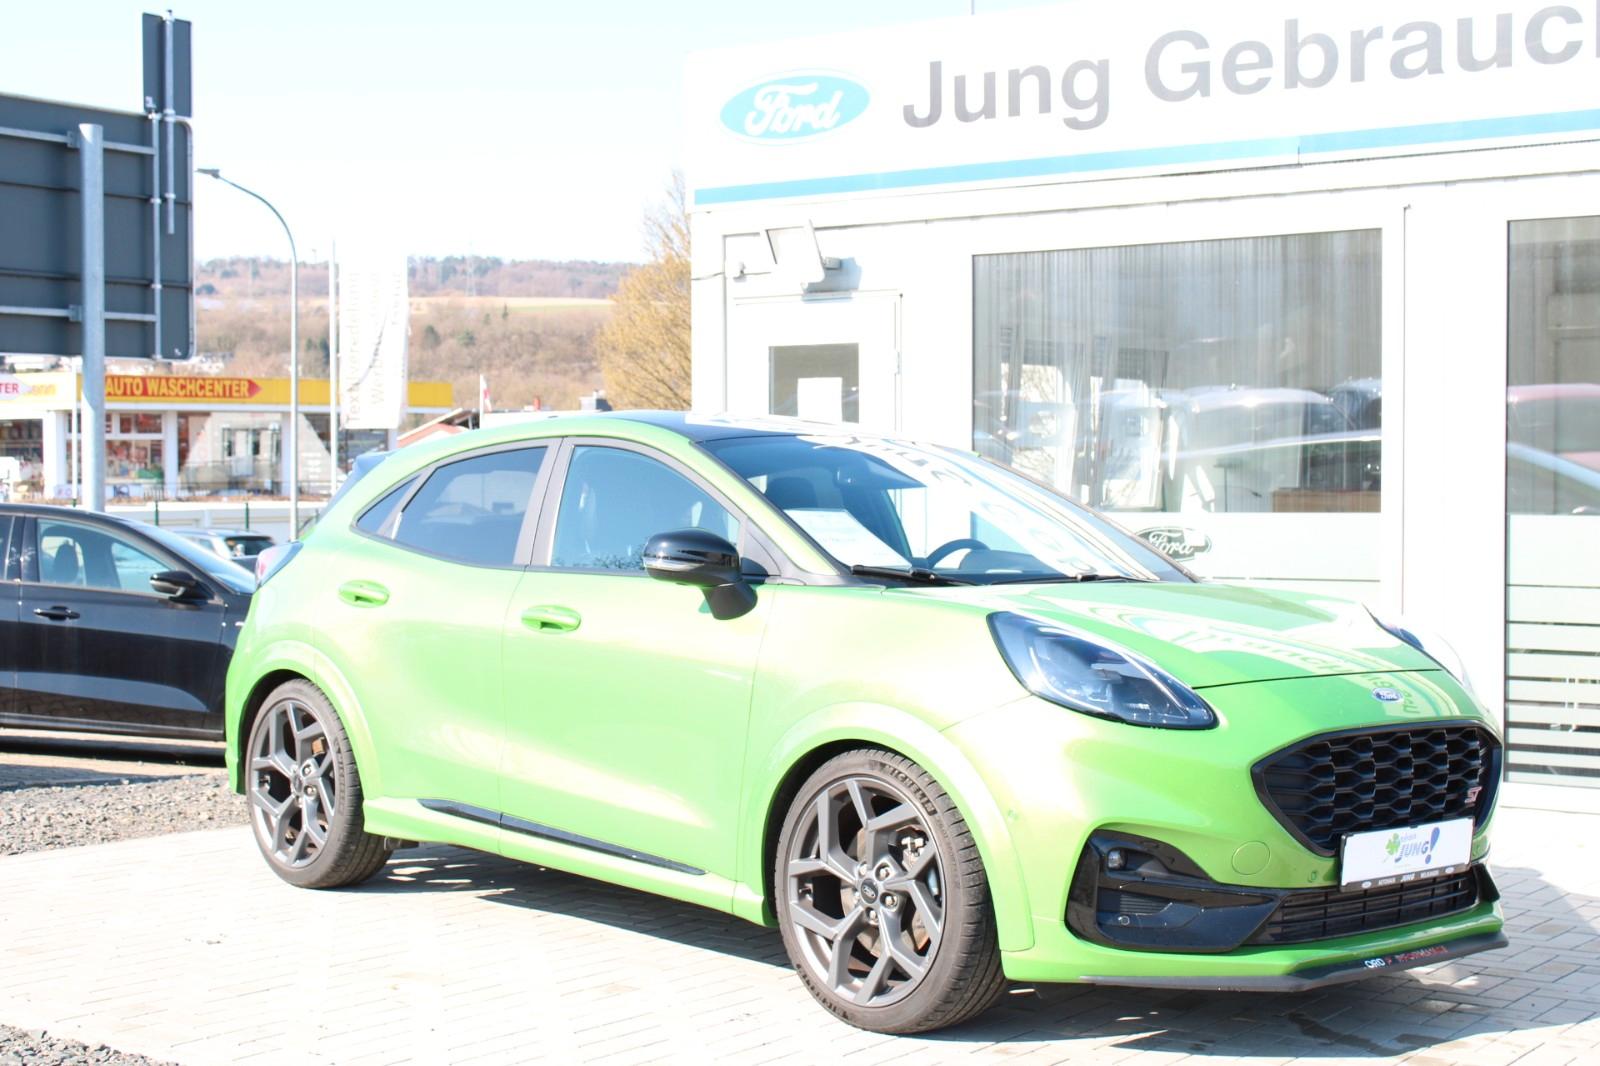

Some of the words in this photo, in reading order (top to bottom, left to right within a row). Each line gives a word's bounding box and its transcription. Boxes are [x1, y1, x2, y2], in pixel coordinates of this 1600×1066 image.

[902, 58, 1110, 131] Jung
[1144, 0, 1600, 102] Gebrauc
[745, 81, 842, 137] Ford
[106, 376, 144, 396] AUTO
[147, 377, 249, 397] WASCHCENTER
